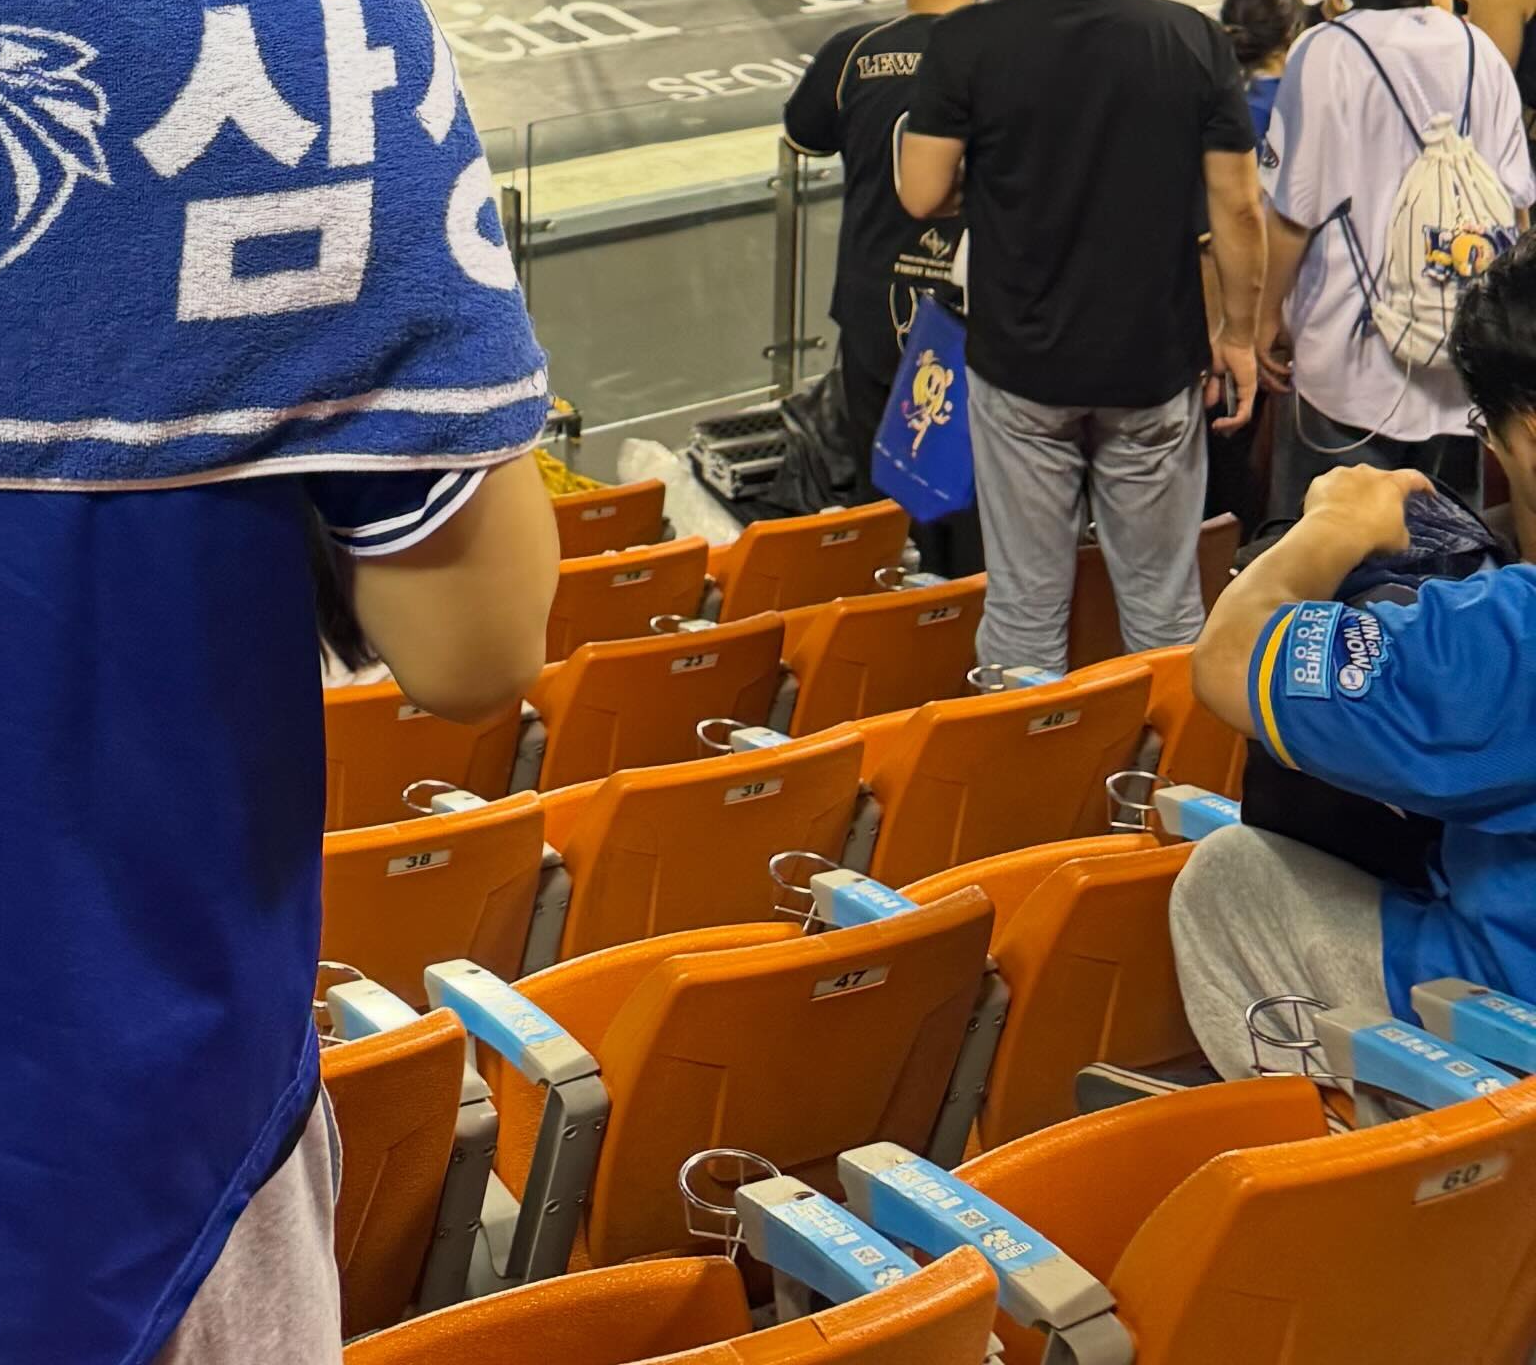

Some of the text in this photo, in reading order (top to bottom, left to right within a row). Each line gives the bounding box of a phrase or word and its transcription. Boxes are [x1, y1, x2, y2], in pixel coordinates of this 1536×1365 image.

[857, 52, 923, 80] LEW
[1293, 607, 1330, 684] 삼성생명
[1343, 626, 1374, 671] WOW
[406, 853, 432, 869] 38
[834, 969, 870, 989] 47
